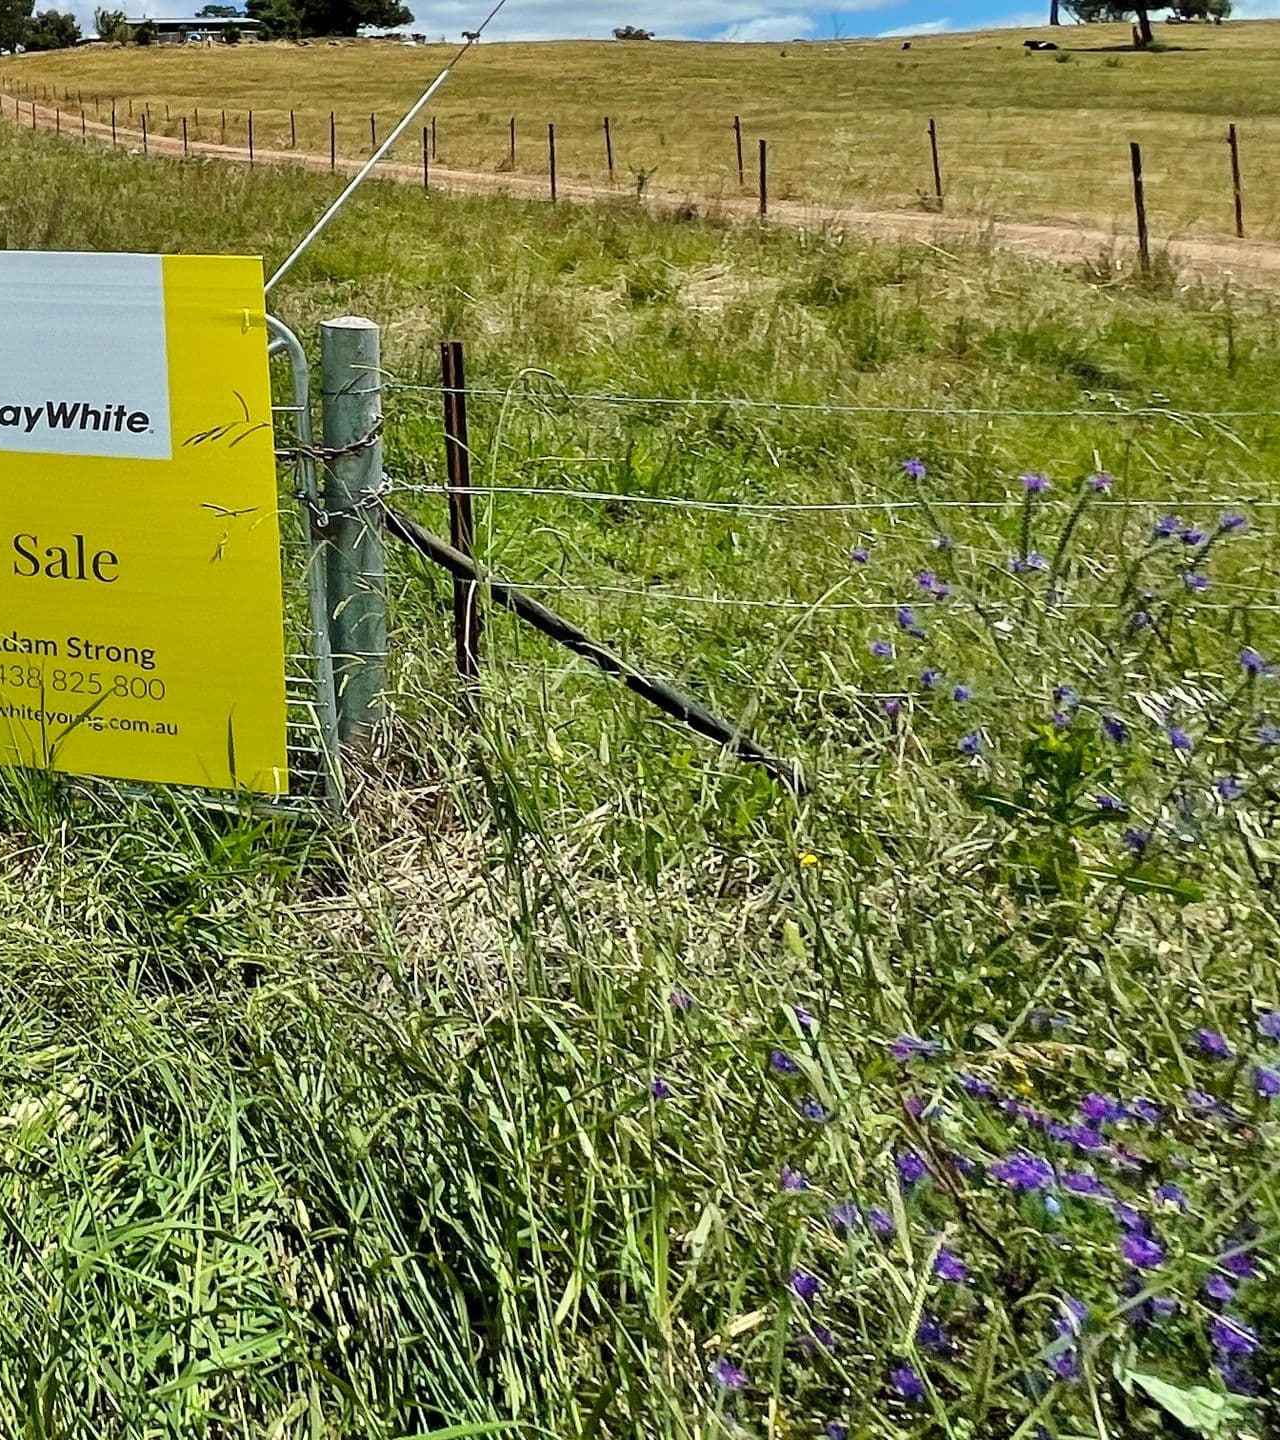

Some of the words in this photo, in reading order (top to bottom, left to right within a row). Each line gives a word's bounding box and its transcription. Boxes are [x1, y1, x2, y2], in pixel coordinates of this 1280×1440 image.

[13, 534, 119, 582] Sale
[66, 637, 156, 670] Strong
[52, 669, 103, 695] 825
[113, 674, 166, 701] 800
